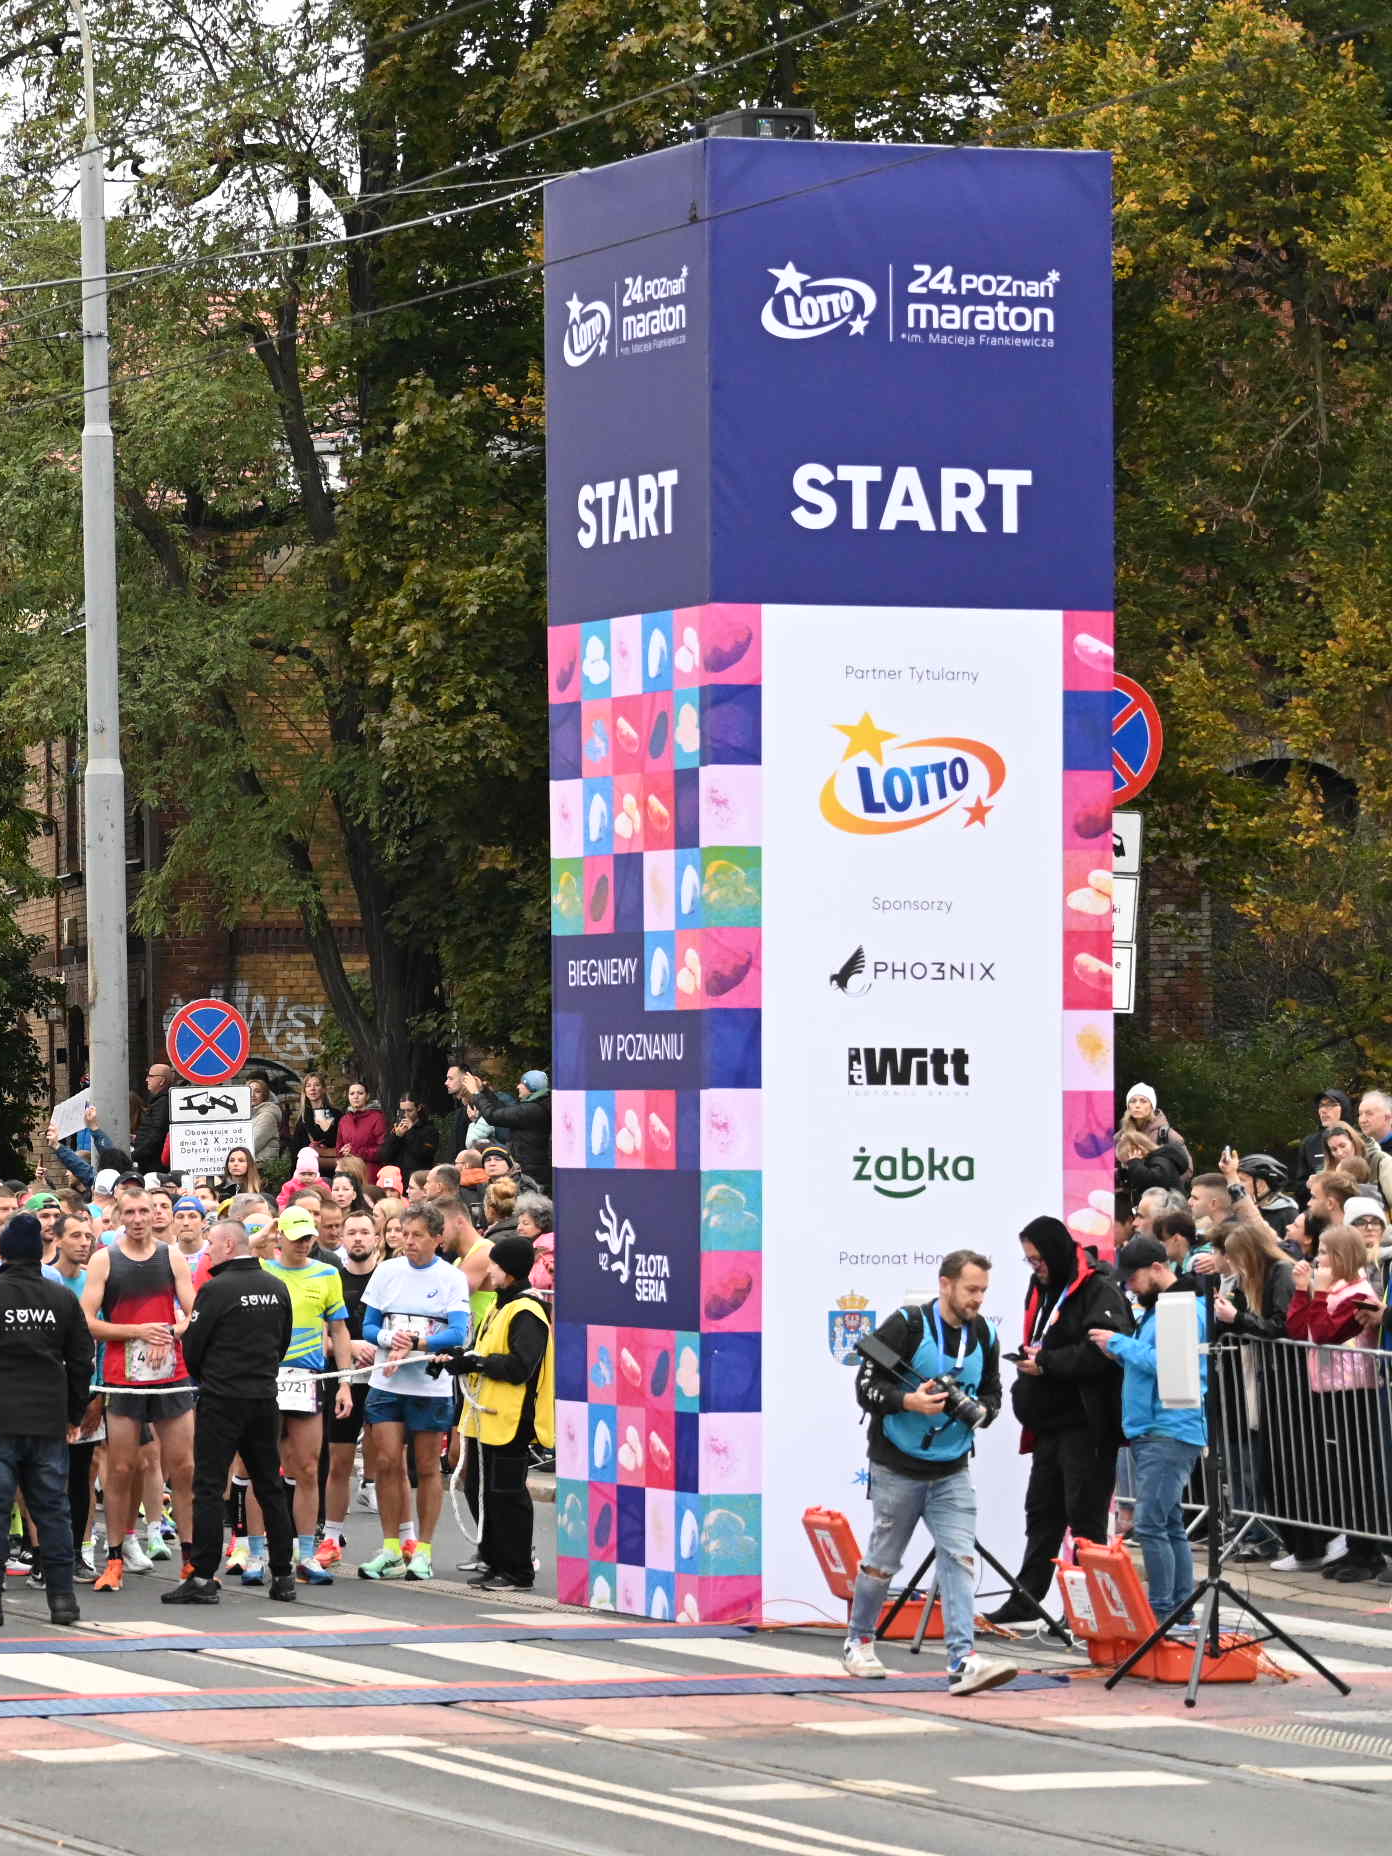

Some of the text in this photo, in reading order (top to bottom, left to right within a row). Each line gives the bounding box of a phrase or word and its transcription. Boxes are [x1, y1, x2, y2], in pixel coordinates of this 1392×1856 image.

[782, 289, 855, 327] LOTTO
[908, 301, 1055, 333] maraton
[571, 312, 603, 354] LOTTO
[622, 303, 687, 341] maraton
[928, 333, 975, 347] Macieja
[979, 334, 1055, 348] Frankiewicza
[577, 469, 678, 550] START
[790, 462, 1033, 535] START
[844, 666, 979, 685] Partner Tytularny
[856, 756, 969, 814] LOTTO
[871, 896, 953, 914] Sponsorzy
[568, 957, 638, 988] BIEGNIEMY
[599, 1032, 685, 1062] W POZNANIU
[200, 1137, 209, 1146] 12
[213, 1136, 220, 1145] X
[852, 1146, 975, 1181] żabka
[635, 1254, 670, 1278] ZŁOTA
[839, 1251, 909, 1265] Patronat
[240, 1294, 279, 1306] SOWA
[635, 1278, 667, 1302] SERIA
[4, 1308, 56, 1323] SOWA
[277, 1381, 308, 1394] 3721
